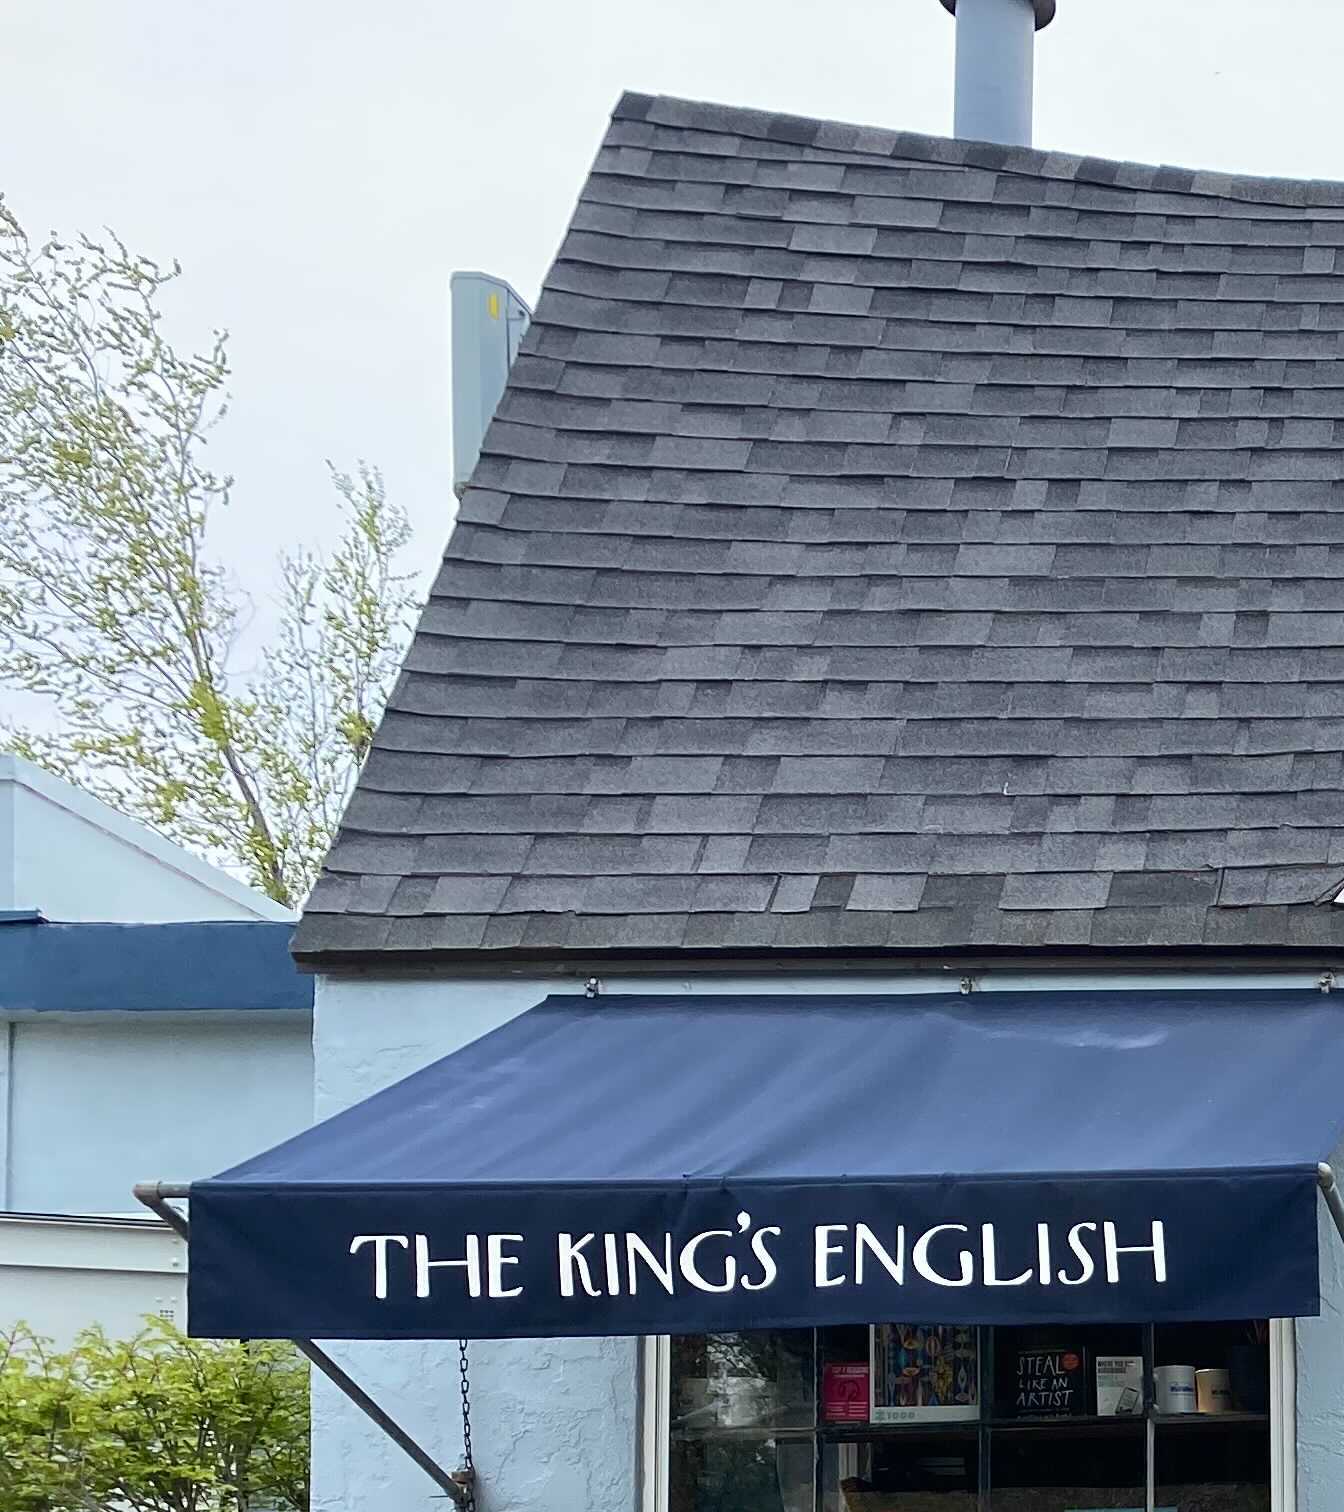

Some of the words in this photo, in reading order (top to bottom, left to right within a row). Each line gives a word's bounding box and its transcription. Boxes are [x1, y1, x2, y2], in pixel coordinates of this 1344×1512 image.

[349, 1233, 524, 1299] THE
[560, 1210, 782, 1298] KING'S
[816, 1220, 1166, 1287] ENGLISH
[1016, 1354, 1065, 1375] STEAL
[1019, 1377, 1045, 1391] LIKE
[1052, 1377, 1068, 1390] AN
[1016, 1390, 1074, 1408] ARTIST
